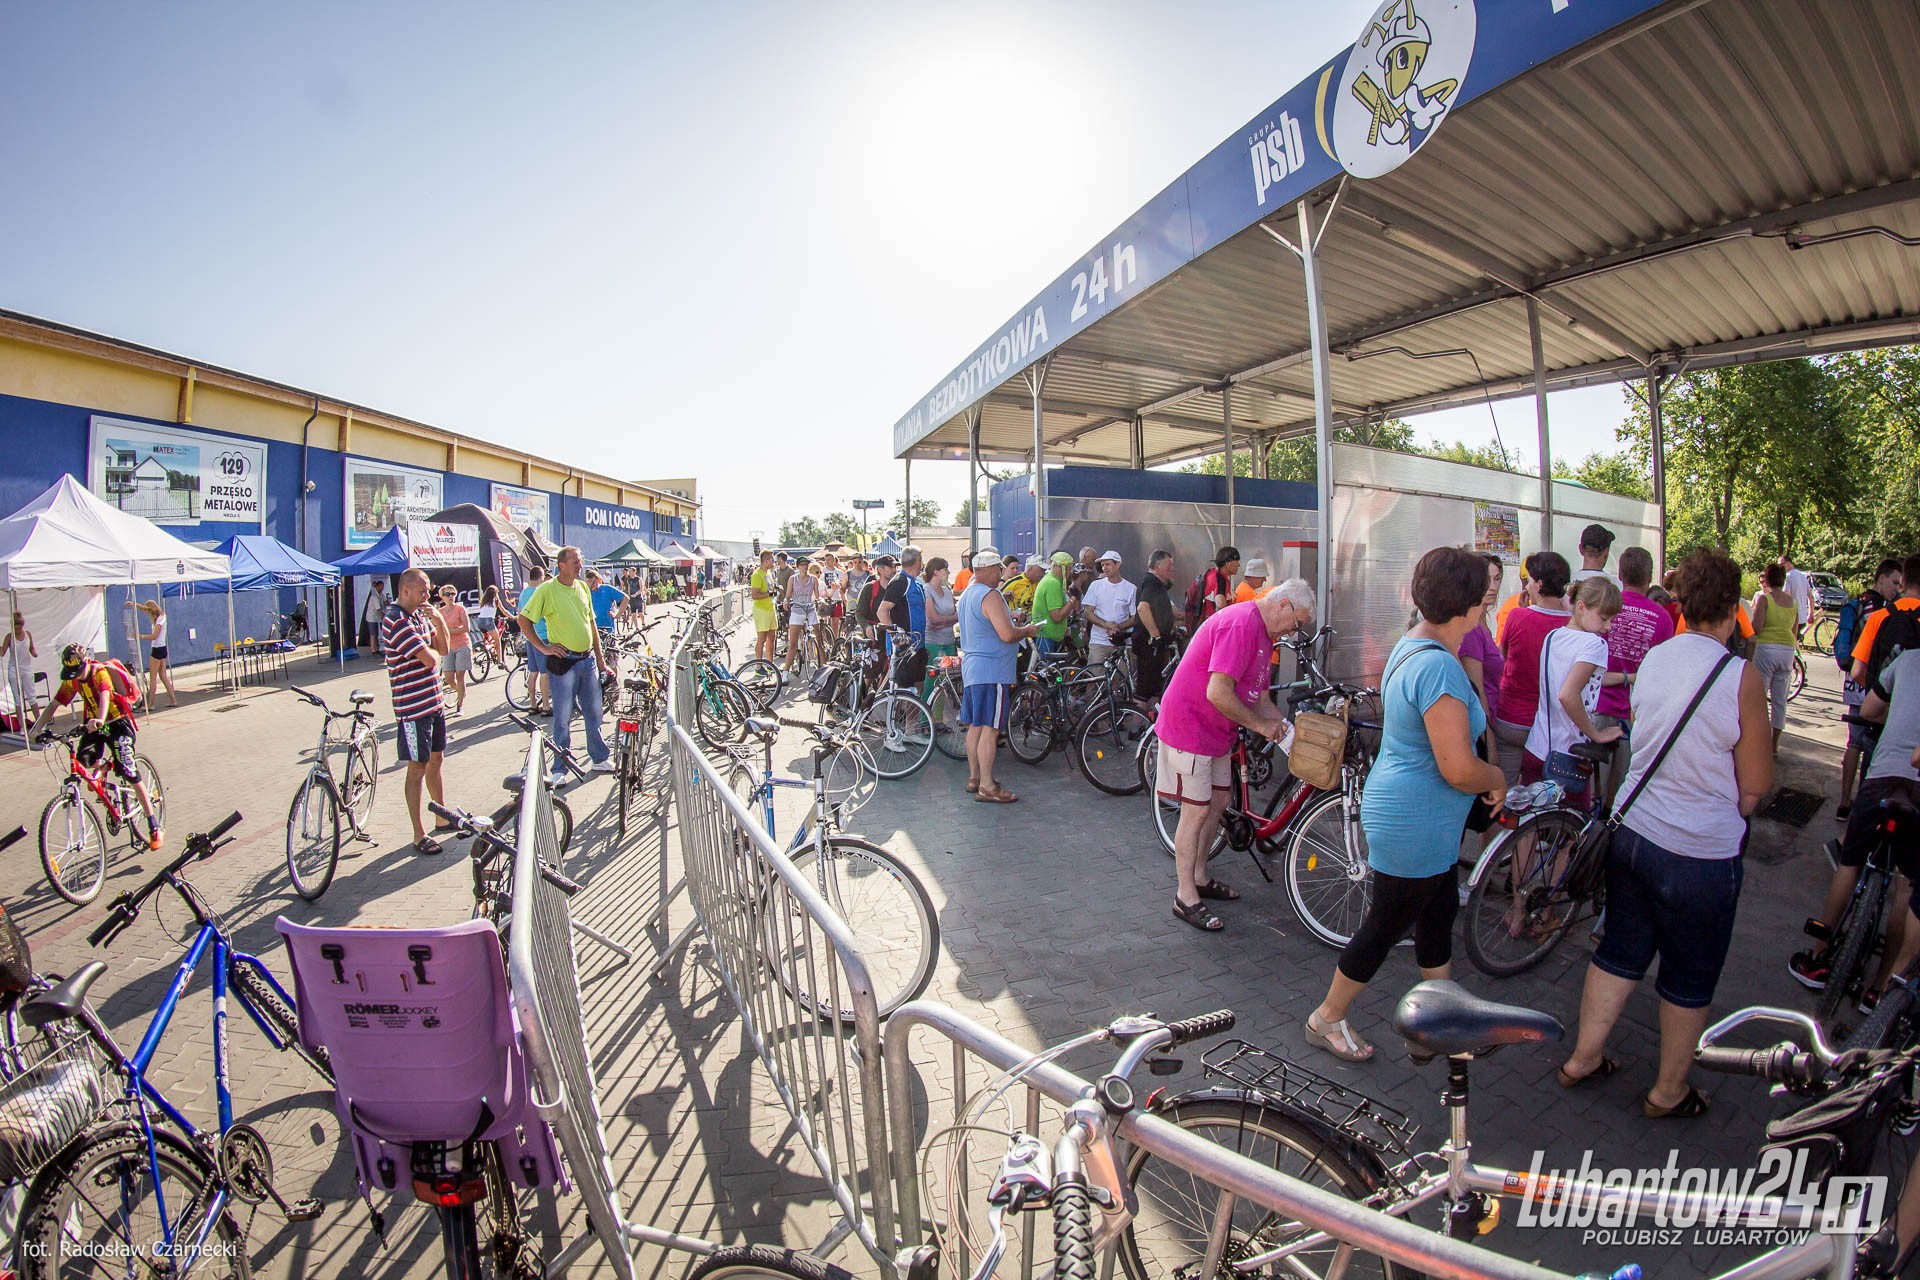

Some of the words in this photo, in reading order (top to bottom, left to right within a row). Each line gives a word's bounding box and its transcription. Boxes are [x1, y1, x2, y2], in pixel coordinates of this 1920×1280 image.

[1248, 121, 1276, 146] GRUPA
[1250, 110, 1306, 206] psb
[895, 408, 923, 450] MYJNIA
[929, 305, 1049, 425] BEZDOTYKOWA
[220, 457, 244, 476] 129
[210, 485, 252, 499] PRZĘSŁO
[204, 498, 257, 512] METALOWE
[585, 506, 607, 526] DOM
[608, 511, 612, 527] I
[613, 511, 640, 530] OGRÓD
[344, 1002, 400, 1015] RÖMER
[401, 1006, 439, 1015] JOCKEY
